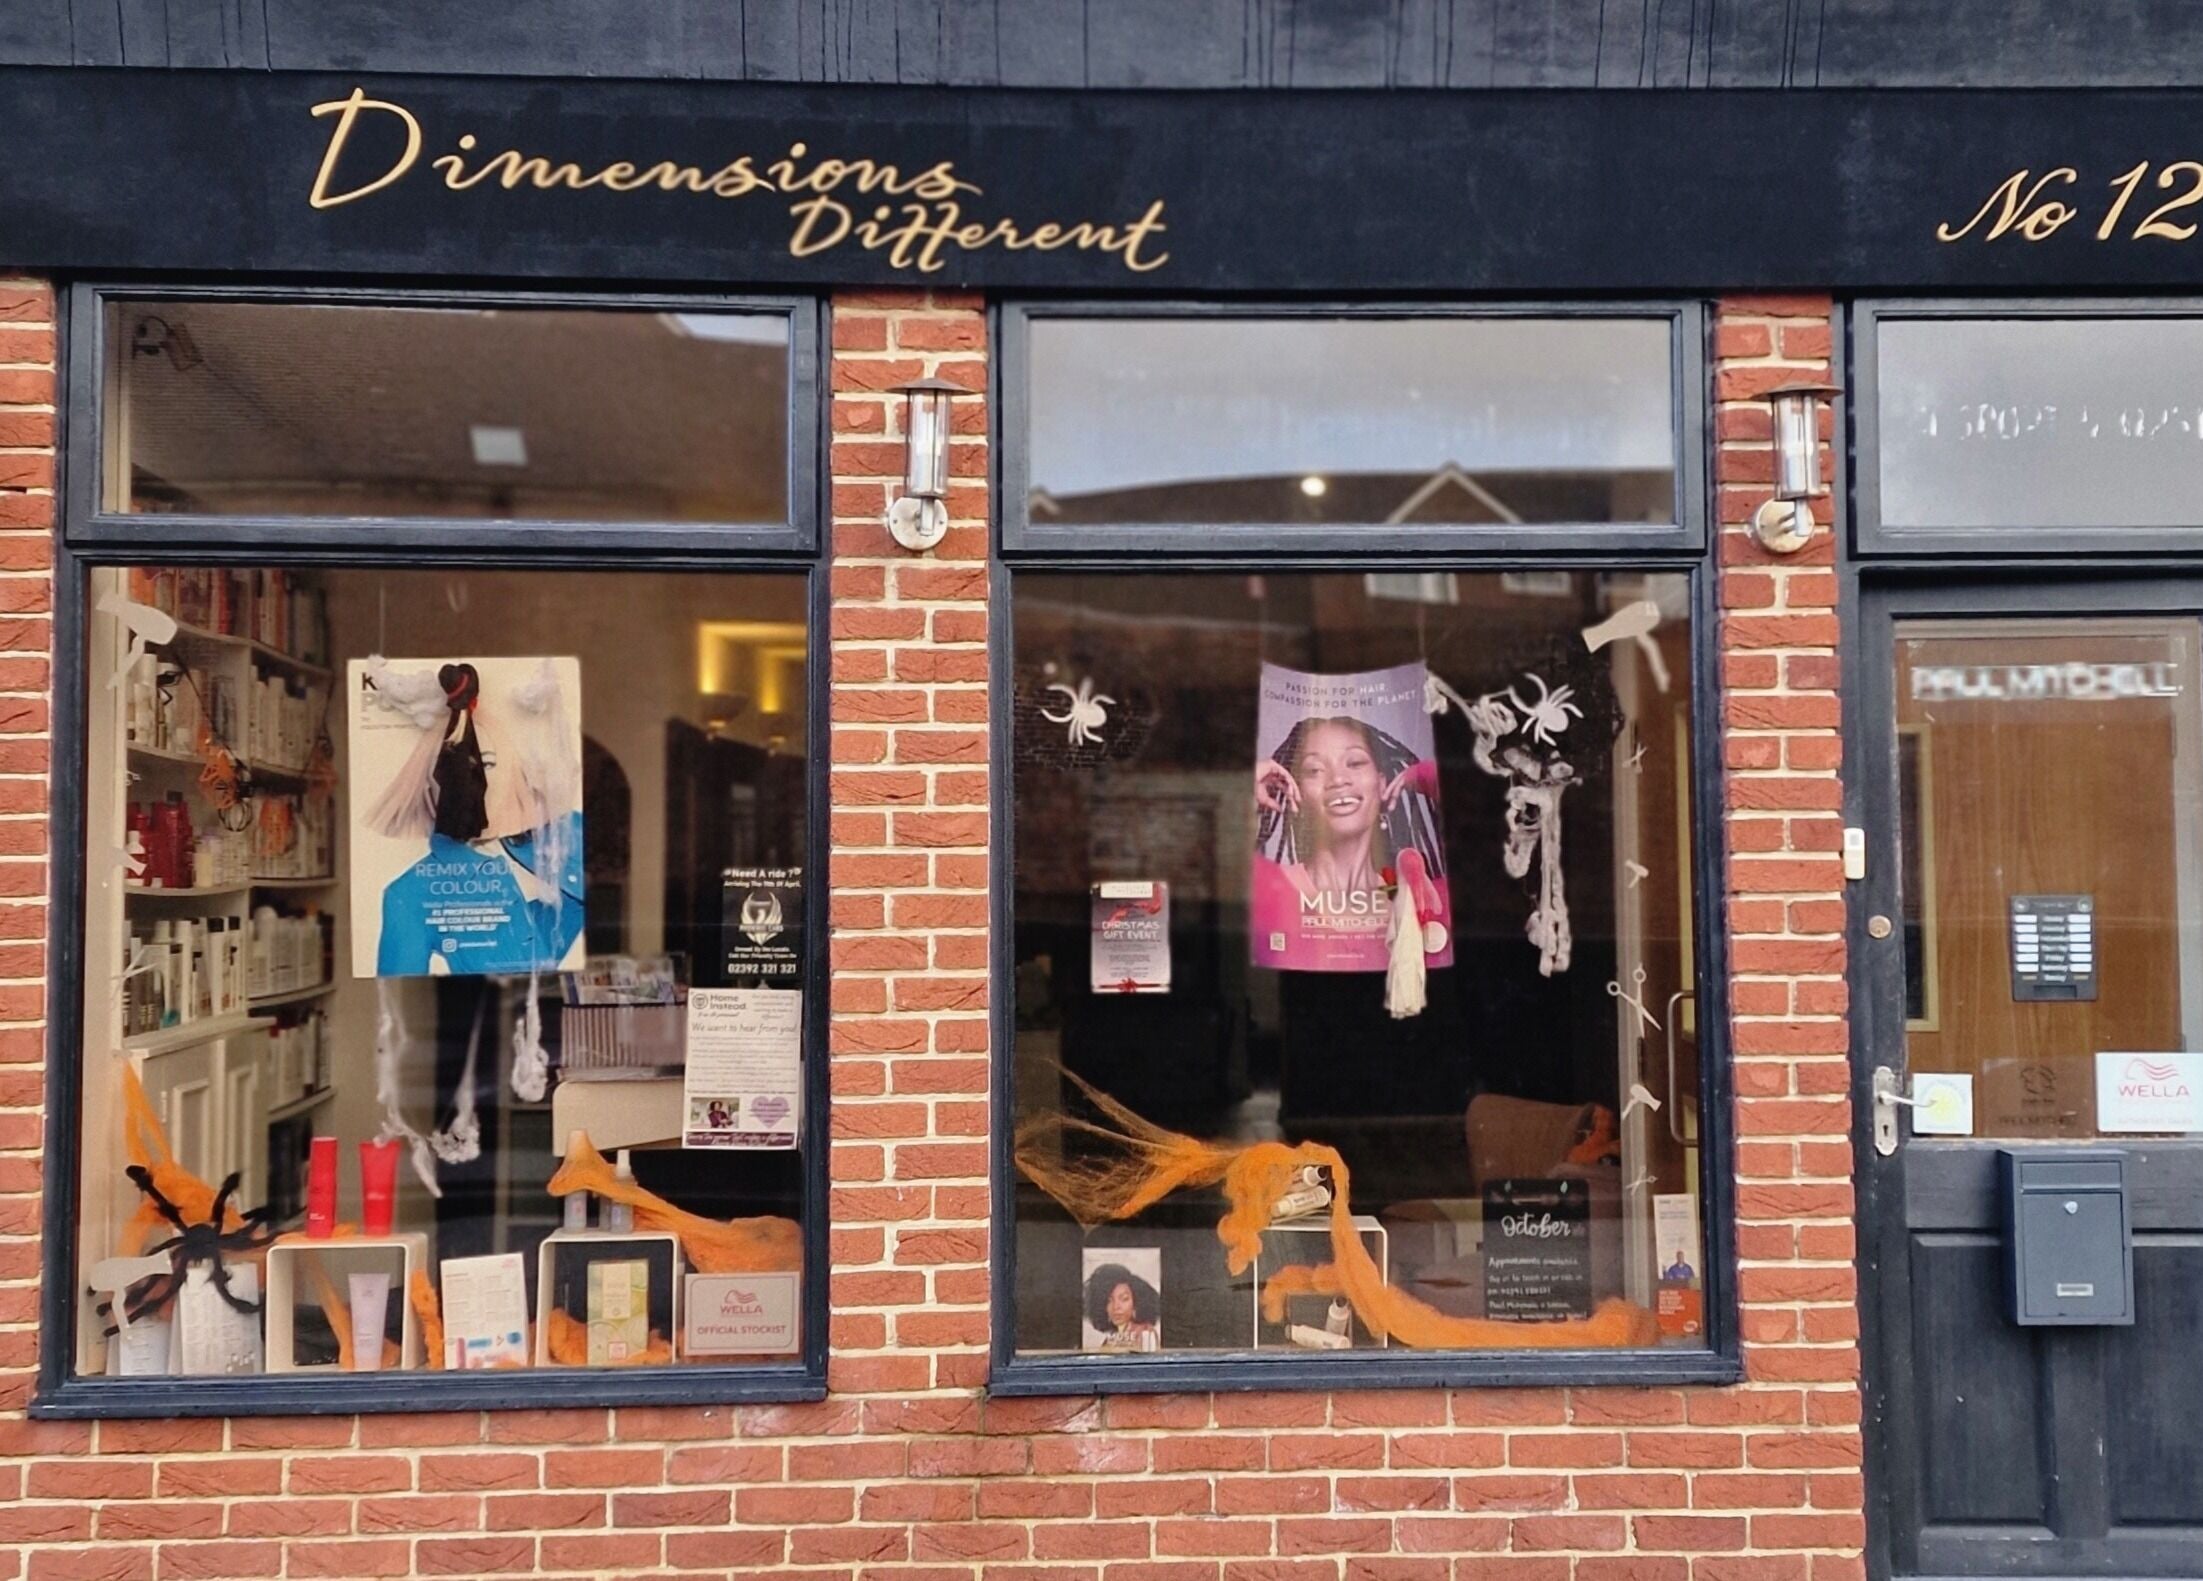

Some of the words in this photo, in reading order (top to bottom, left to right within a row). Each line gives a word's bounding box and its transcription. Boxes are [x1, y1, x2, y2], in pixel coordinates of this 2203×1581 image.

[309, 87, 983, 208] Dimensions
[1936, 168, 2078, 241] No
[2096, 160, 2203, 241] 12
[789, 194, 1168, 272] Different
[1286, 682, 1328, 696] PASSION
[1332, 687, 1355, 696] FOR
[1264, 689, 1321, 708] COMPASSION
[1325, 699, 1347, 709] FOR
[1354, 697, 1373, 706] THE
[415, 863, 468, 877] REMIX
[472, 861, 516, 876] YOU
[1300, 890, 1389, 914] MUSE
[1102, 921, 1160, 931] CHRISTMAS
[1103, 930, 1125, 940] GIFT
[710, 994, 739, 1002] Home
[2118, 1084, 2191, 1098] WELLA
[1501, 1211, 1571, 1238] October
[720, 1305, 763, 1314] WELLA
[697, 1326, 738, 1335] OFFICIAL
[741, 1324, 787, 1334] STOCKIST
